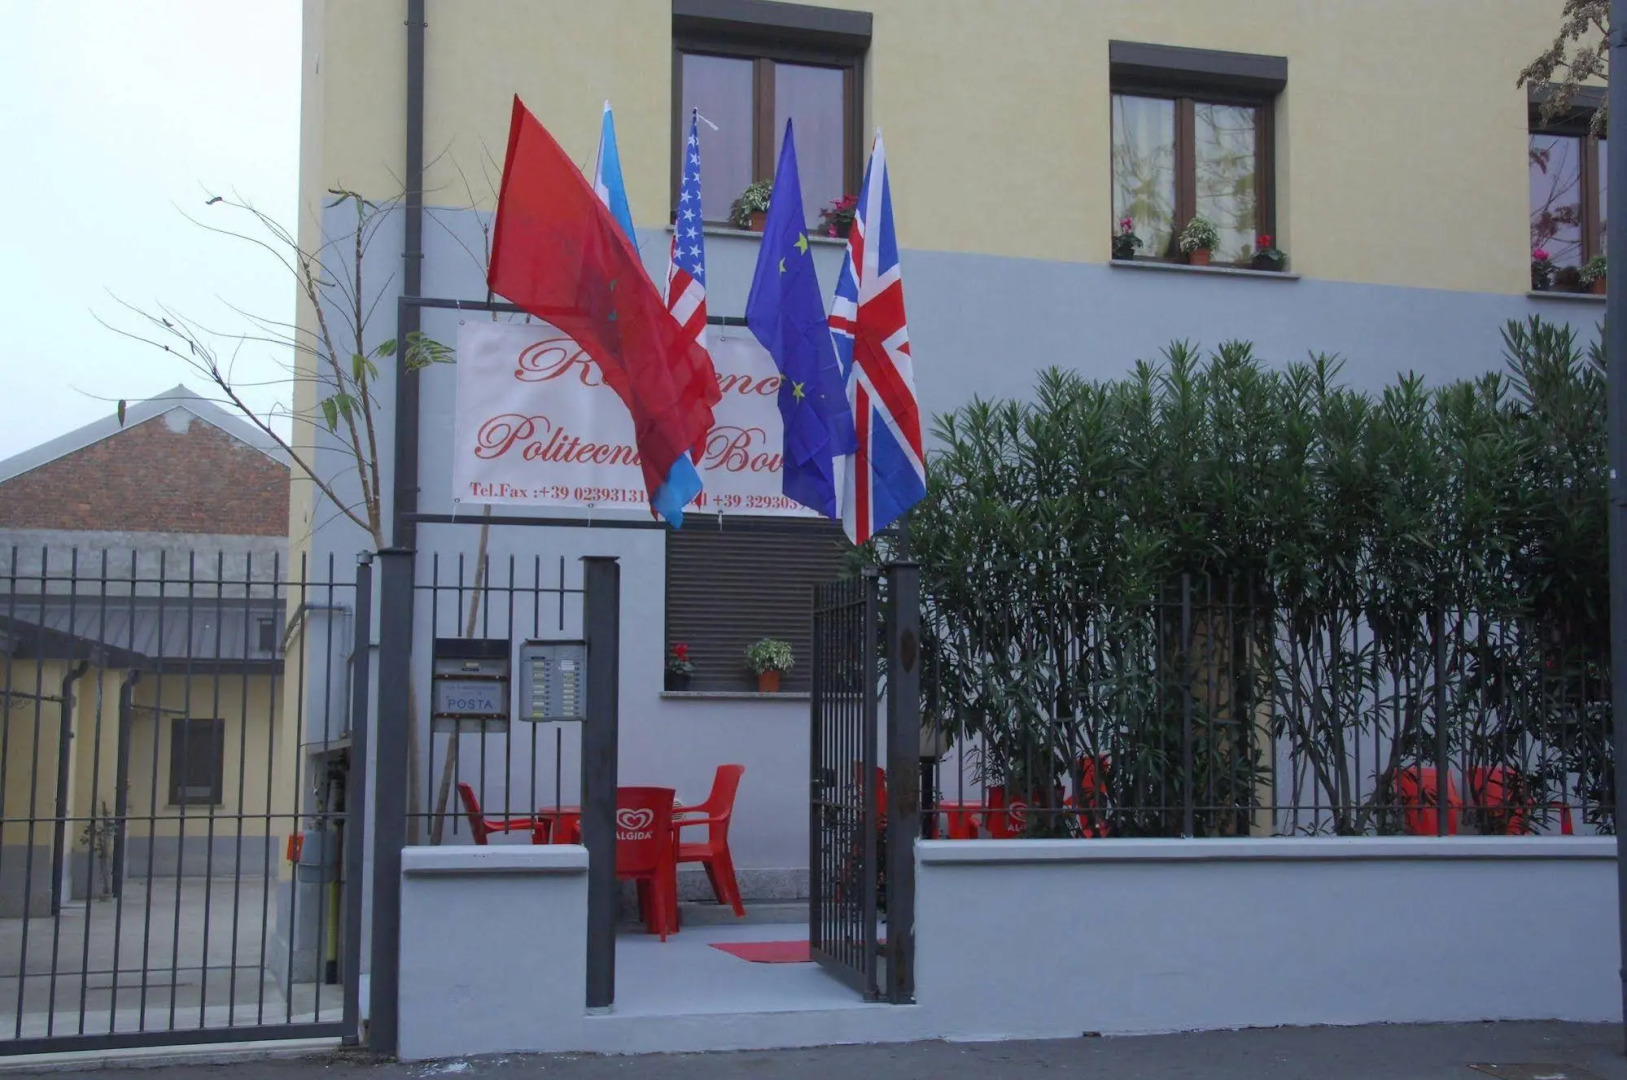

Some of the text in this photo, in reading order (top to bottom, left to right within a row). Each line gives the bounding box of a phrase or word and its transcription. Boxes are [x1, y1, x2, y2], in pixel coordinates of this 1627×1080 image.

[703, 425, 784, 472] Bov
[470, 482, 527, 498] Tel.Fax
[573, 487, 650, 503] 02393131
[713, 494, 742, 509] +39
[746, 495, 806, 510] 329305
[448, 699, 493, 710] POSTA
